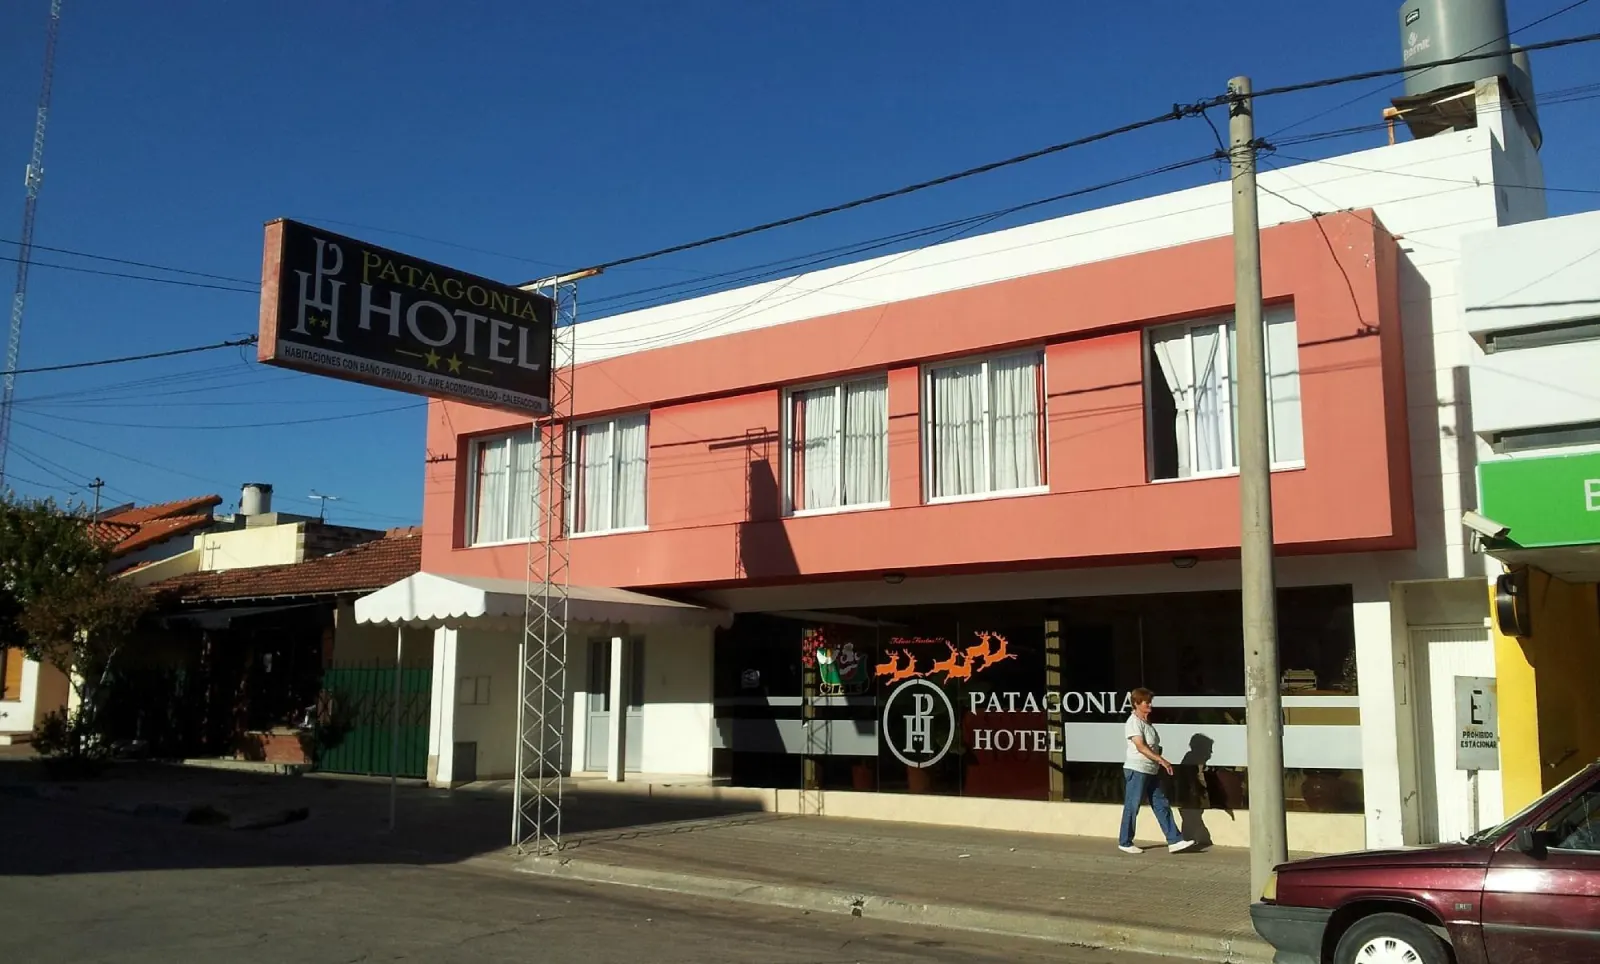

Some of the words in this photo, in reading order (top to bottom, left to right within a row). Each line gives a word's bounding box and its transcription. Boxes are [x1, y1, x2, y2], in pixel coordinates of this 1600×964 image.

[362, 250, 539, 322] PATAGONIA
[358, 283, 540, 371] HOTEL
[284, 345, 341, 367] HABITACIONES
[342, 358, 358, 371] CON
[382, 367, 412, 382] PRIVADO
[428, 377, 444, 389] AIRE
[968, 691, 1133, 715] PATAGONIA
[973, 729, 1064, 752] HOTEL
[1460, 740, 1497, 749] ESTACIONAR
[1462, 731, 1493, 739] PROHIBIDO
